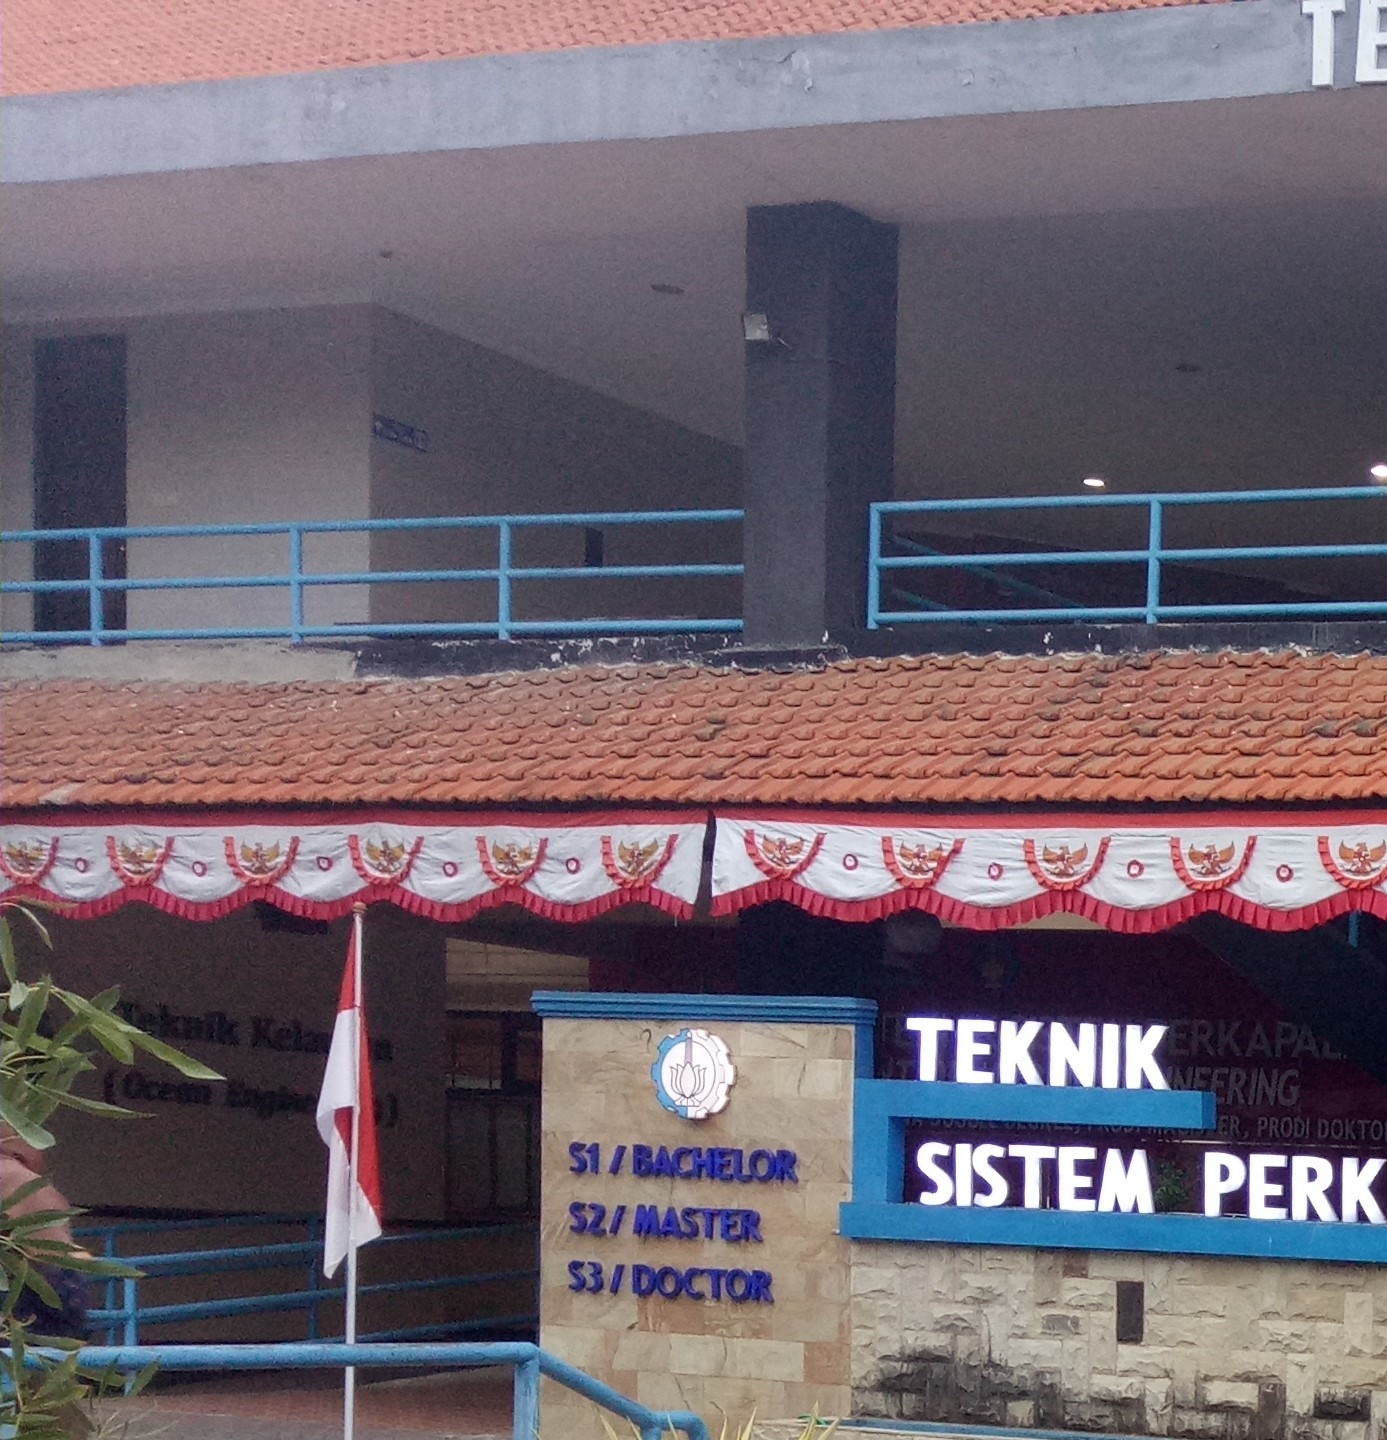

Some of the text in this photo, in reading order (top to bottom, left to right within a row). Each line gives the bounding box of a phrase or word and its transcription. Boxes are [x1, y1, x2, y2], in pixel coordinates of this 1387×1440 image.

[906, 1017, 1171, 1090] TEKNIK
[1257, 1115, 1310, 1139] PRODI
[569, 1142, 601, 1175] S1
[632, 1144, 799, 1184] BACHELOR
[917, 1141, 1155, 1213] SISTEM
[569, 1202, 607, 1236] S2
[633, 1204, 764, 1243] MASTER
[568, 1260, 604, 1295] S3
[632, 1265, 775, 1304] DOCTOR
